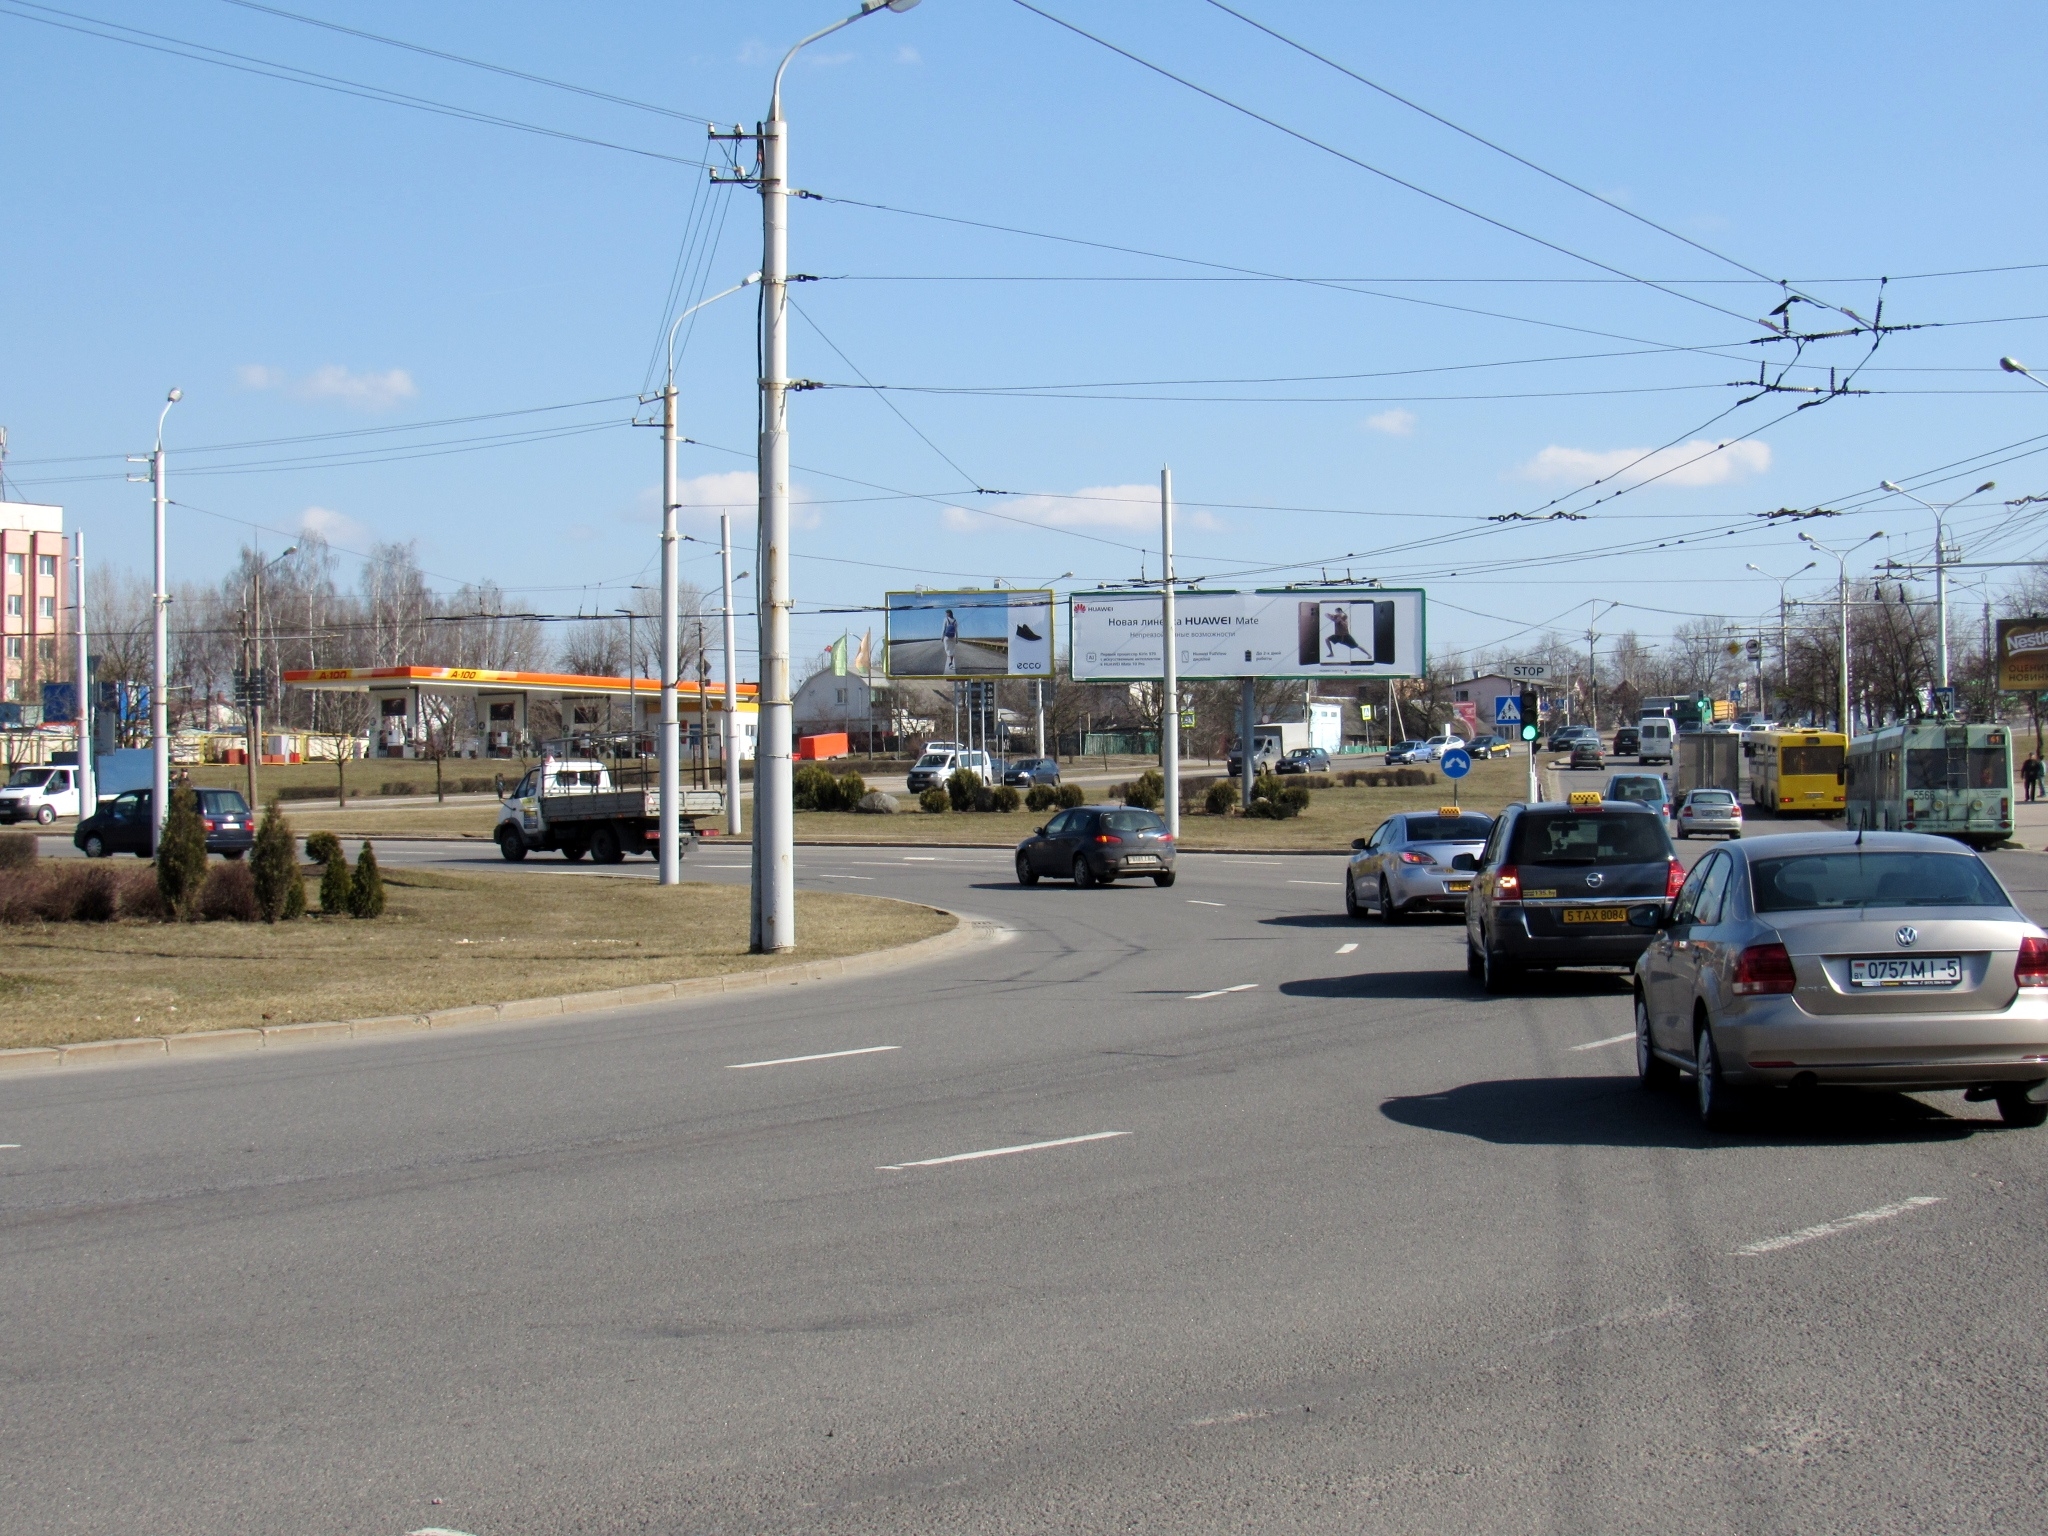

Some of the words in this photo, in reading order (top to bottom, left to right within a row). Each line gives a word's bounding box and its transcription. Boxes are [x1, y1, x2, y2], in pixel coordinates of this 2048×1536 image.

[1108, 618, 1138, 627] Новая
[1185, 616, 1231, 625] HUAWEI
[1235, 616, 1259, 625] Mate
[1016, 662, 1042, 670] ecco
[1513, 666, 1544, 676] STOP
[1913, 790, 1936, 801] 5566
[1567, 910, 1574, 922] 5
[1576, 909, 1599, 921] TAX
[1600, 909, 1625, 920] 8084
[1854, 972, 1863, 980] BY
